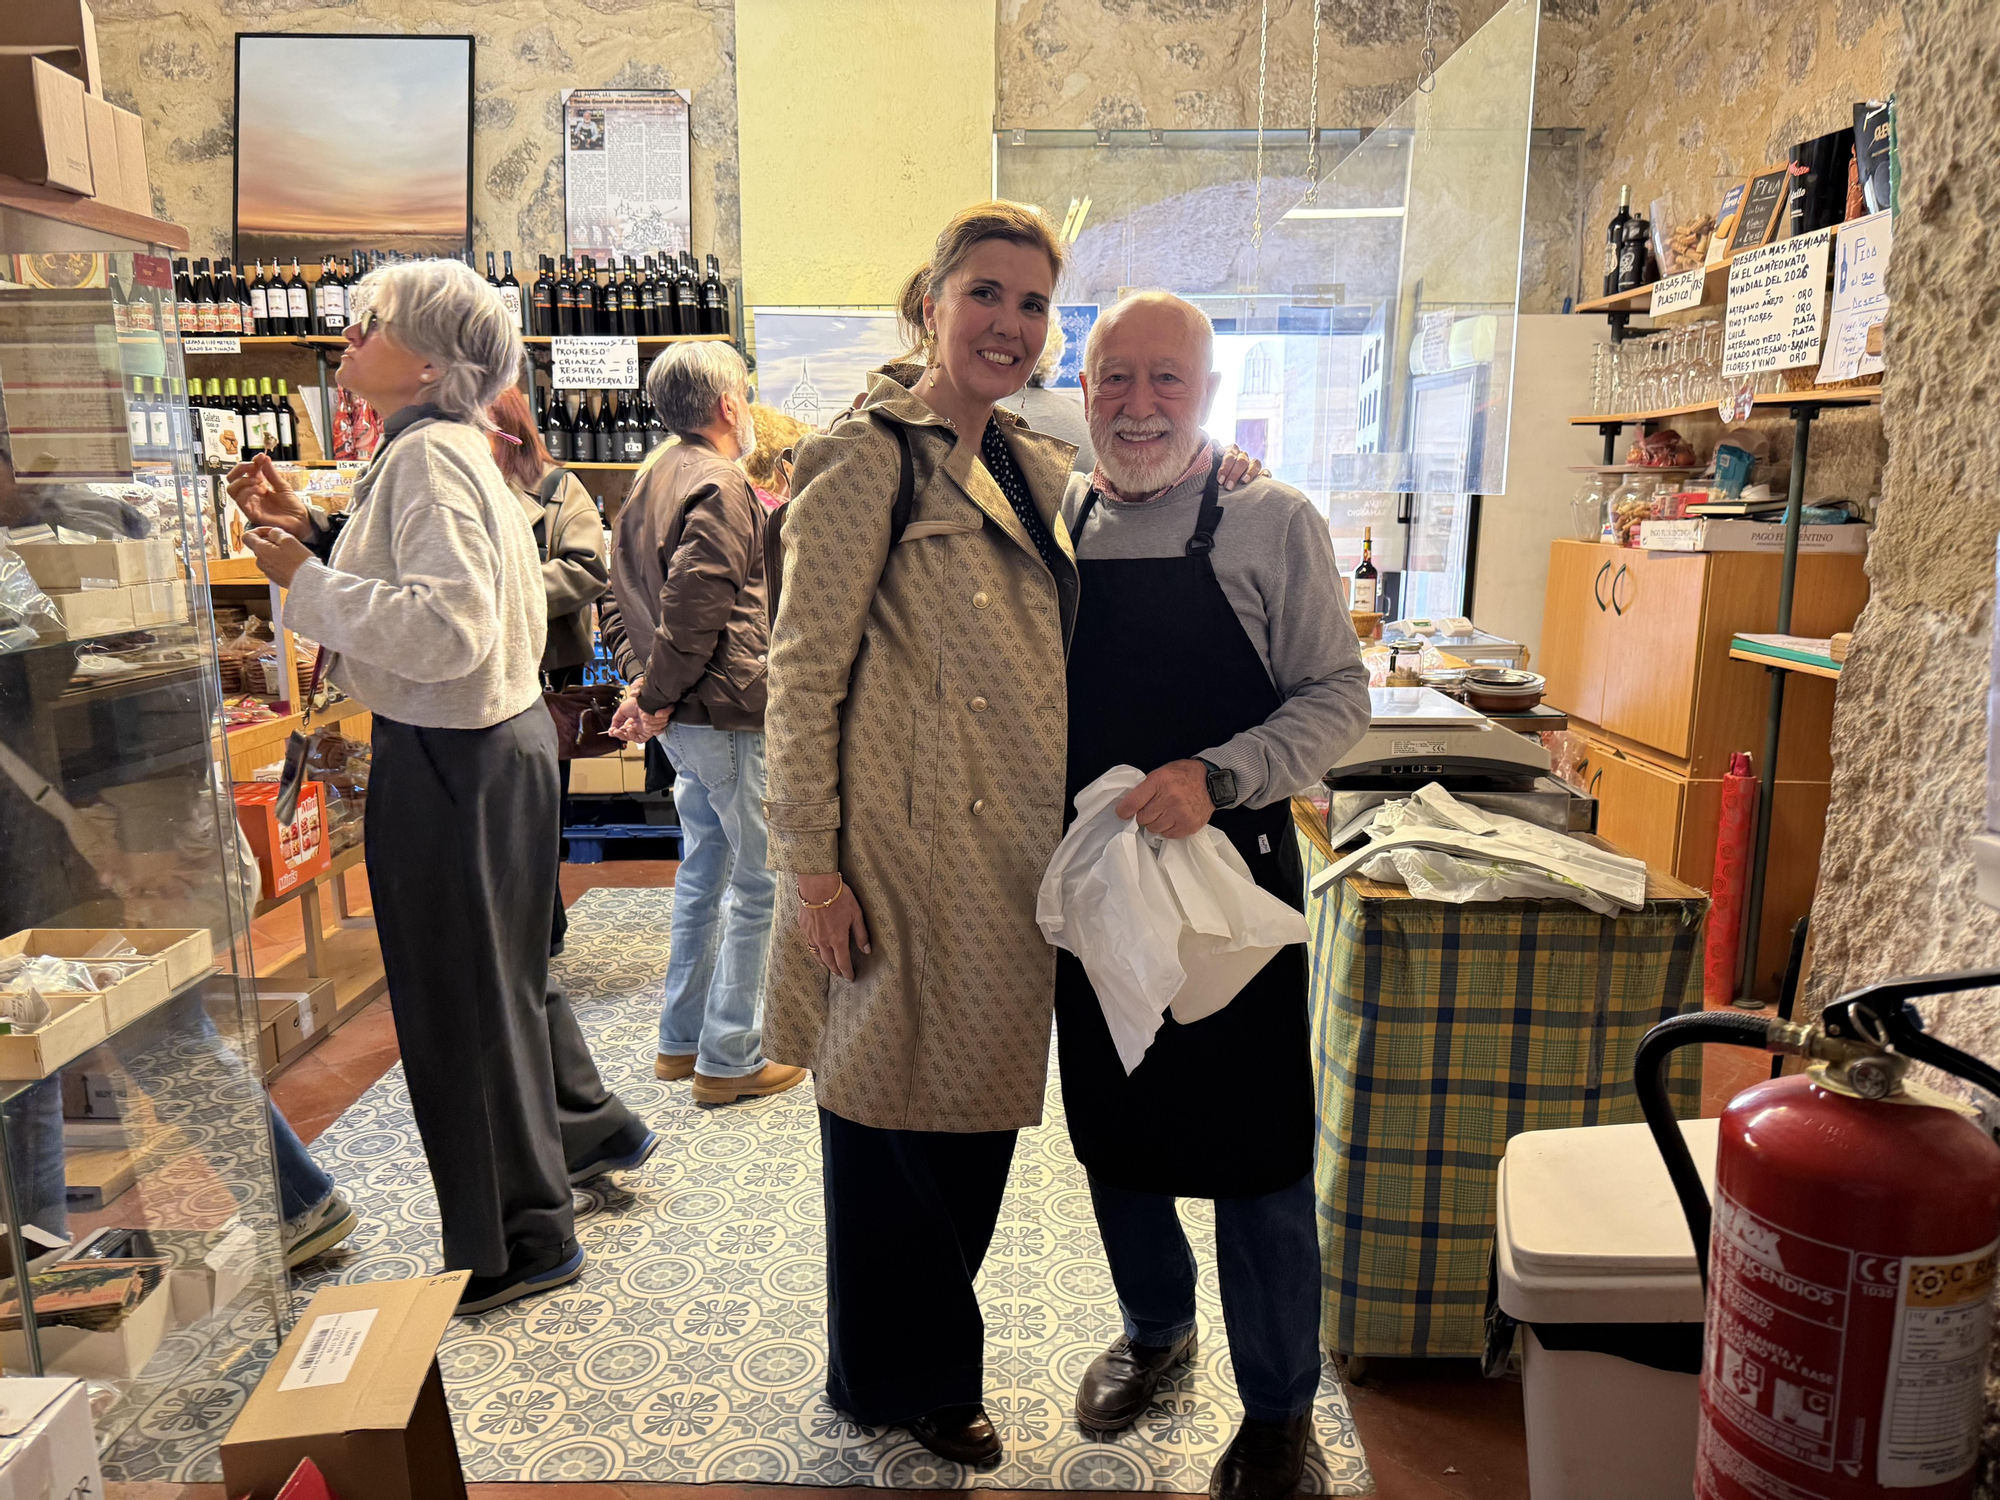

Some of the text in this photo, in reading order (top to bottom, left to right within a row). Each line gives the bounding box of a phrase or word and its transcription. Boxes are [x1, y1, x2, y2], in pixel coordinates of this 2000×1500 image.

[1768, 244, 1786, 256] MAS
[1788, 232, 1829, 252] PREMIADA
[1730, 253, 1806, 281] EN EL CAMPEONATO
[1655, 278, 1680, 293] BOLSAS
[1681, 274, 1692, 286] DE
[1730, 263, 1810, 297] MUNDIAL DEL 2026
[1657, 290, 1688, 307] PLASTICO
[1728, 302, 1759, 314] ARTESANO
[1798, 288, 1813, 300] ORO
[1748, 312, 1773, 324] FLORES
[1796, 302, 1811, 314] ORO
[1793, 313, 1816, 327] PLATA
[1727, 338, 1760, 351] ARTESANO
[1792, 325, 1814, 338] PLATA
[1726, 351, 1806, 373] FLORES Y VINO ORO
[558, 376, 583, 385] GRAN
[586, 376, 622, 385] RESERVA
[1650, 529, 1692, 537] PAGO FLORENTINO
[1751, 532, 1833, 542] PAGO FLENTINO
[278, 869, 298, 891] Minis
[1736, 1250, 1834, 1306] INCENDIOS
[1860, 1258, 1899, 1284] CE
[1861, 1285, 1895, 1299] 1035
[1744, 1366, 1757, 1382] B
[1782, 1358, 1798, 1373] LA
[1801, 1367, 1834, 1385] BASE
[1808, 1394, 1825, 1412] C
